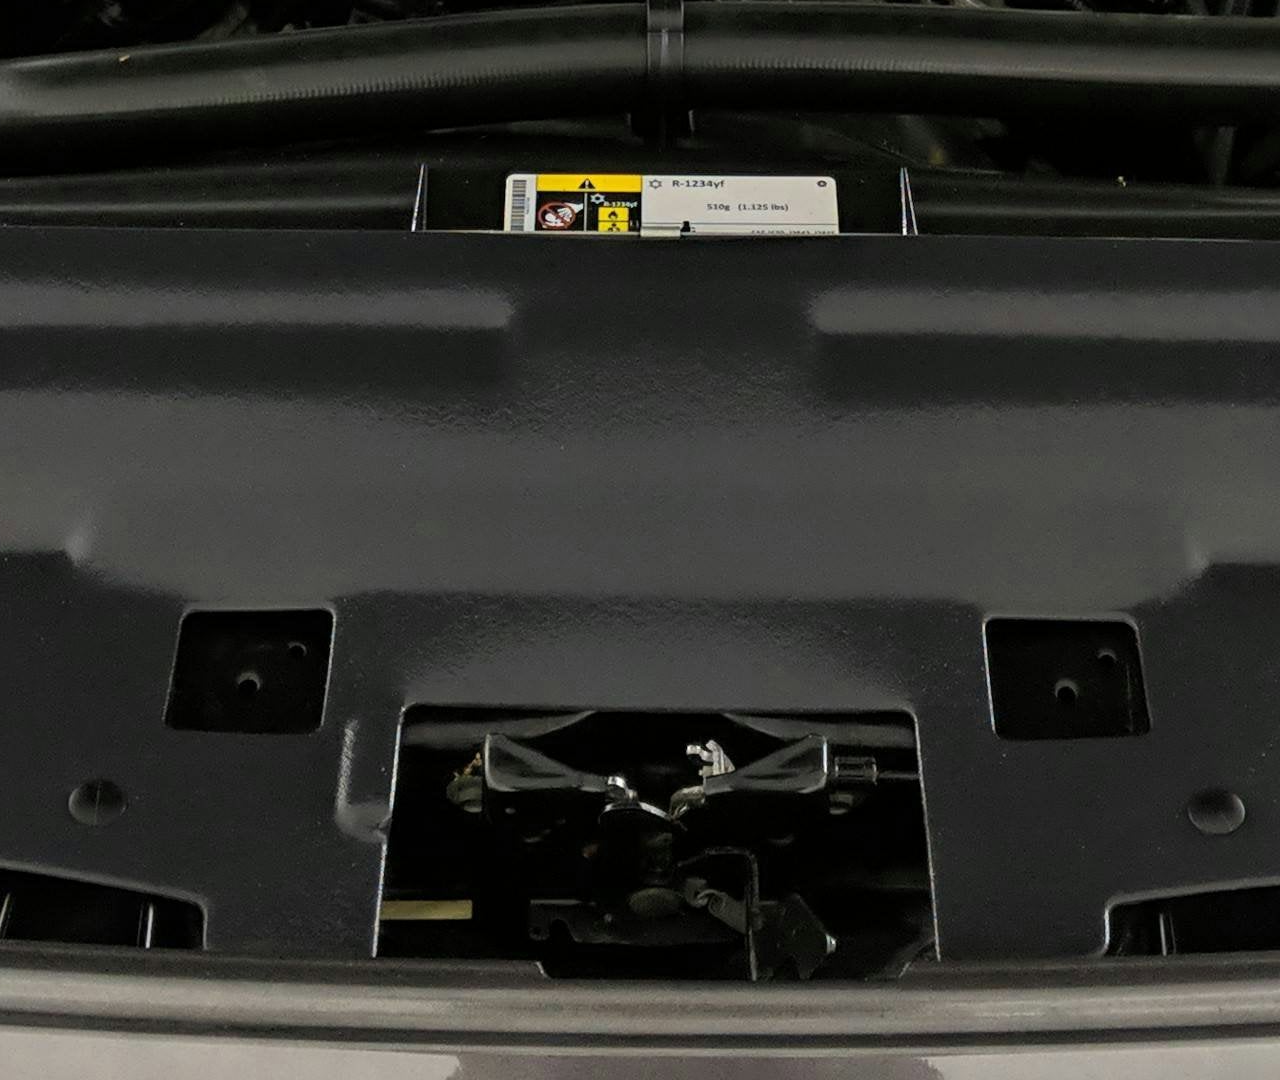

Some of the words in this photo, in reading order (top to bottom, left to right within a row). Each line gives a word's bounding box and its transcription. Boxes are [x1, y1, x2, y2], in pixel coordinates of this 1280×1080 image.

[672, 179, 725, 190] R-1234yf
[707, 203, 730, 212] 510g
[738, 203, 768, 212] (1.125
[770, 203, 789, 212] lbs)
